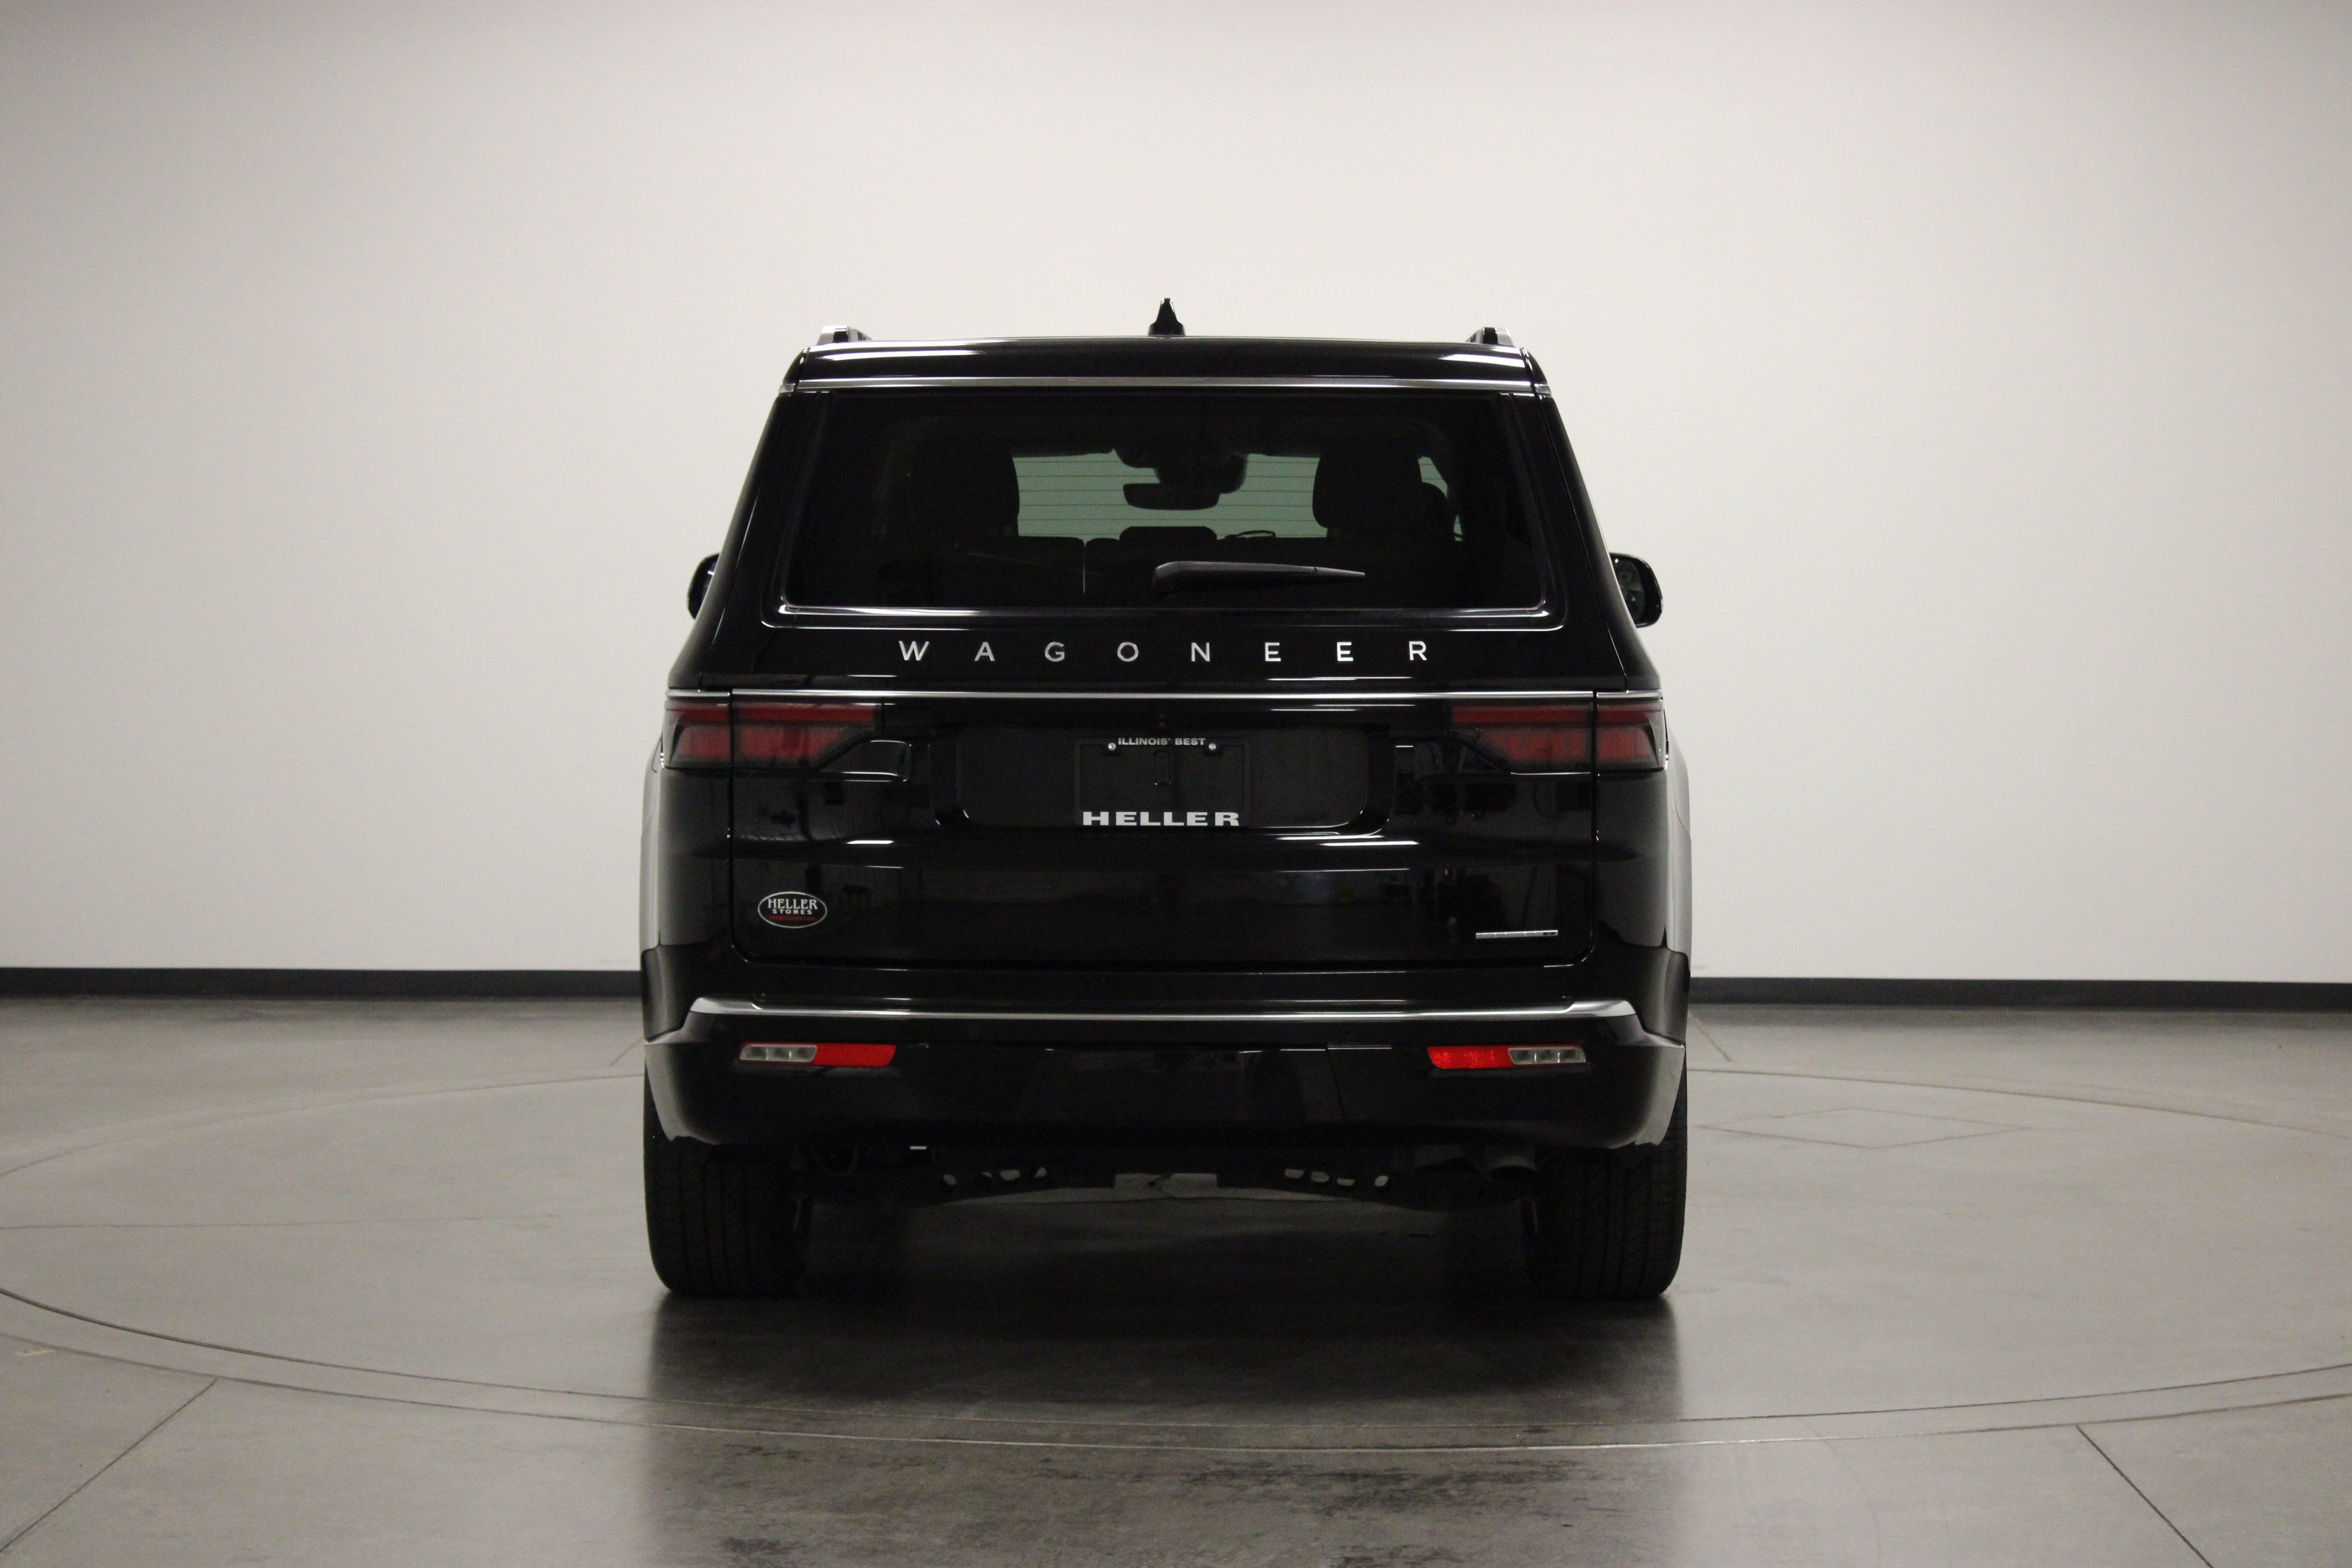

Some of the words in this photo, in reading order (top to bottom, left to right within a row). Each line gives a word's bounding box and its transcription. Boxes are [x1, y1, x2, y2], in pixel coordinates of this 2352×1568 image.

[898, 640, 1427, 662] WAGONEER
[1082, 811, 1239, 826] HELLER
[768, 899, 818, 909] HELLER
